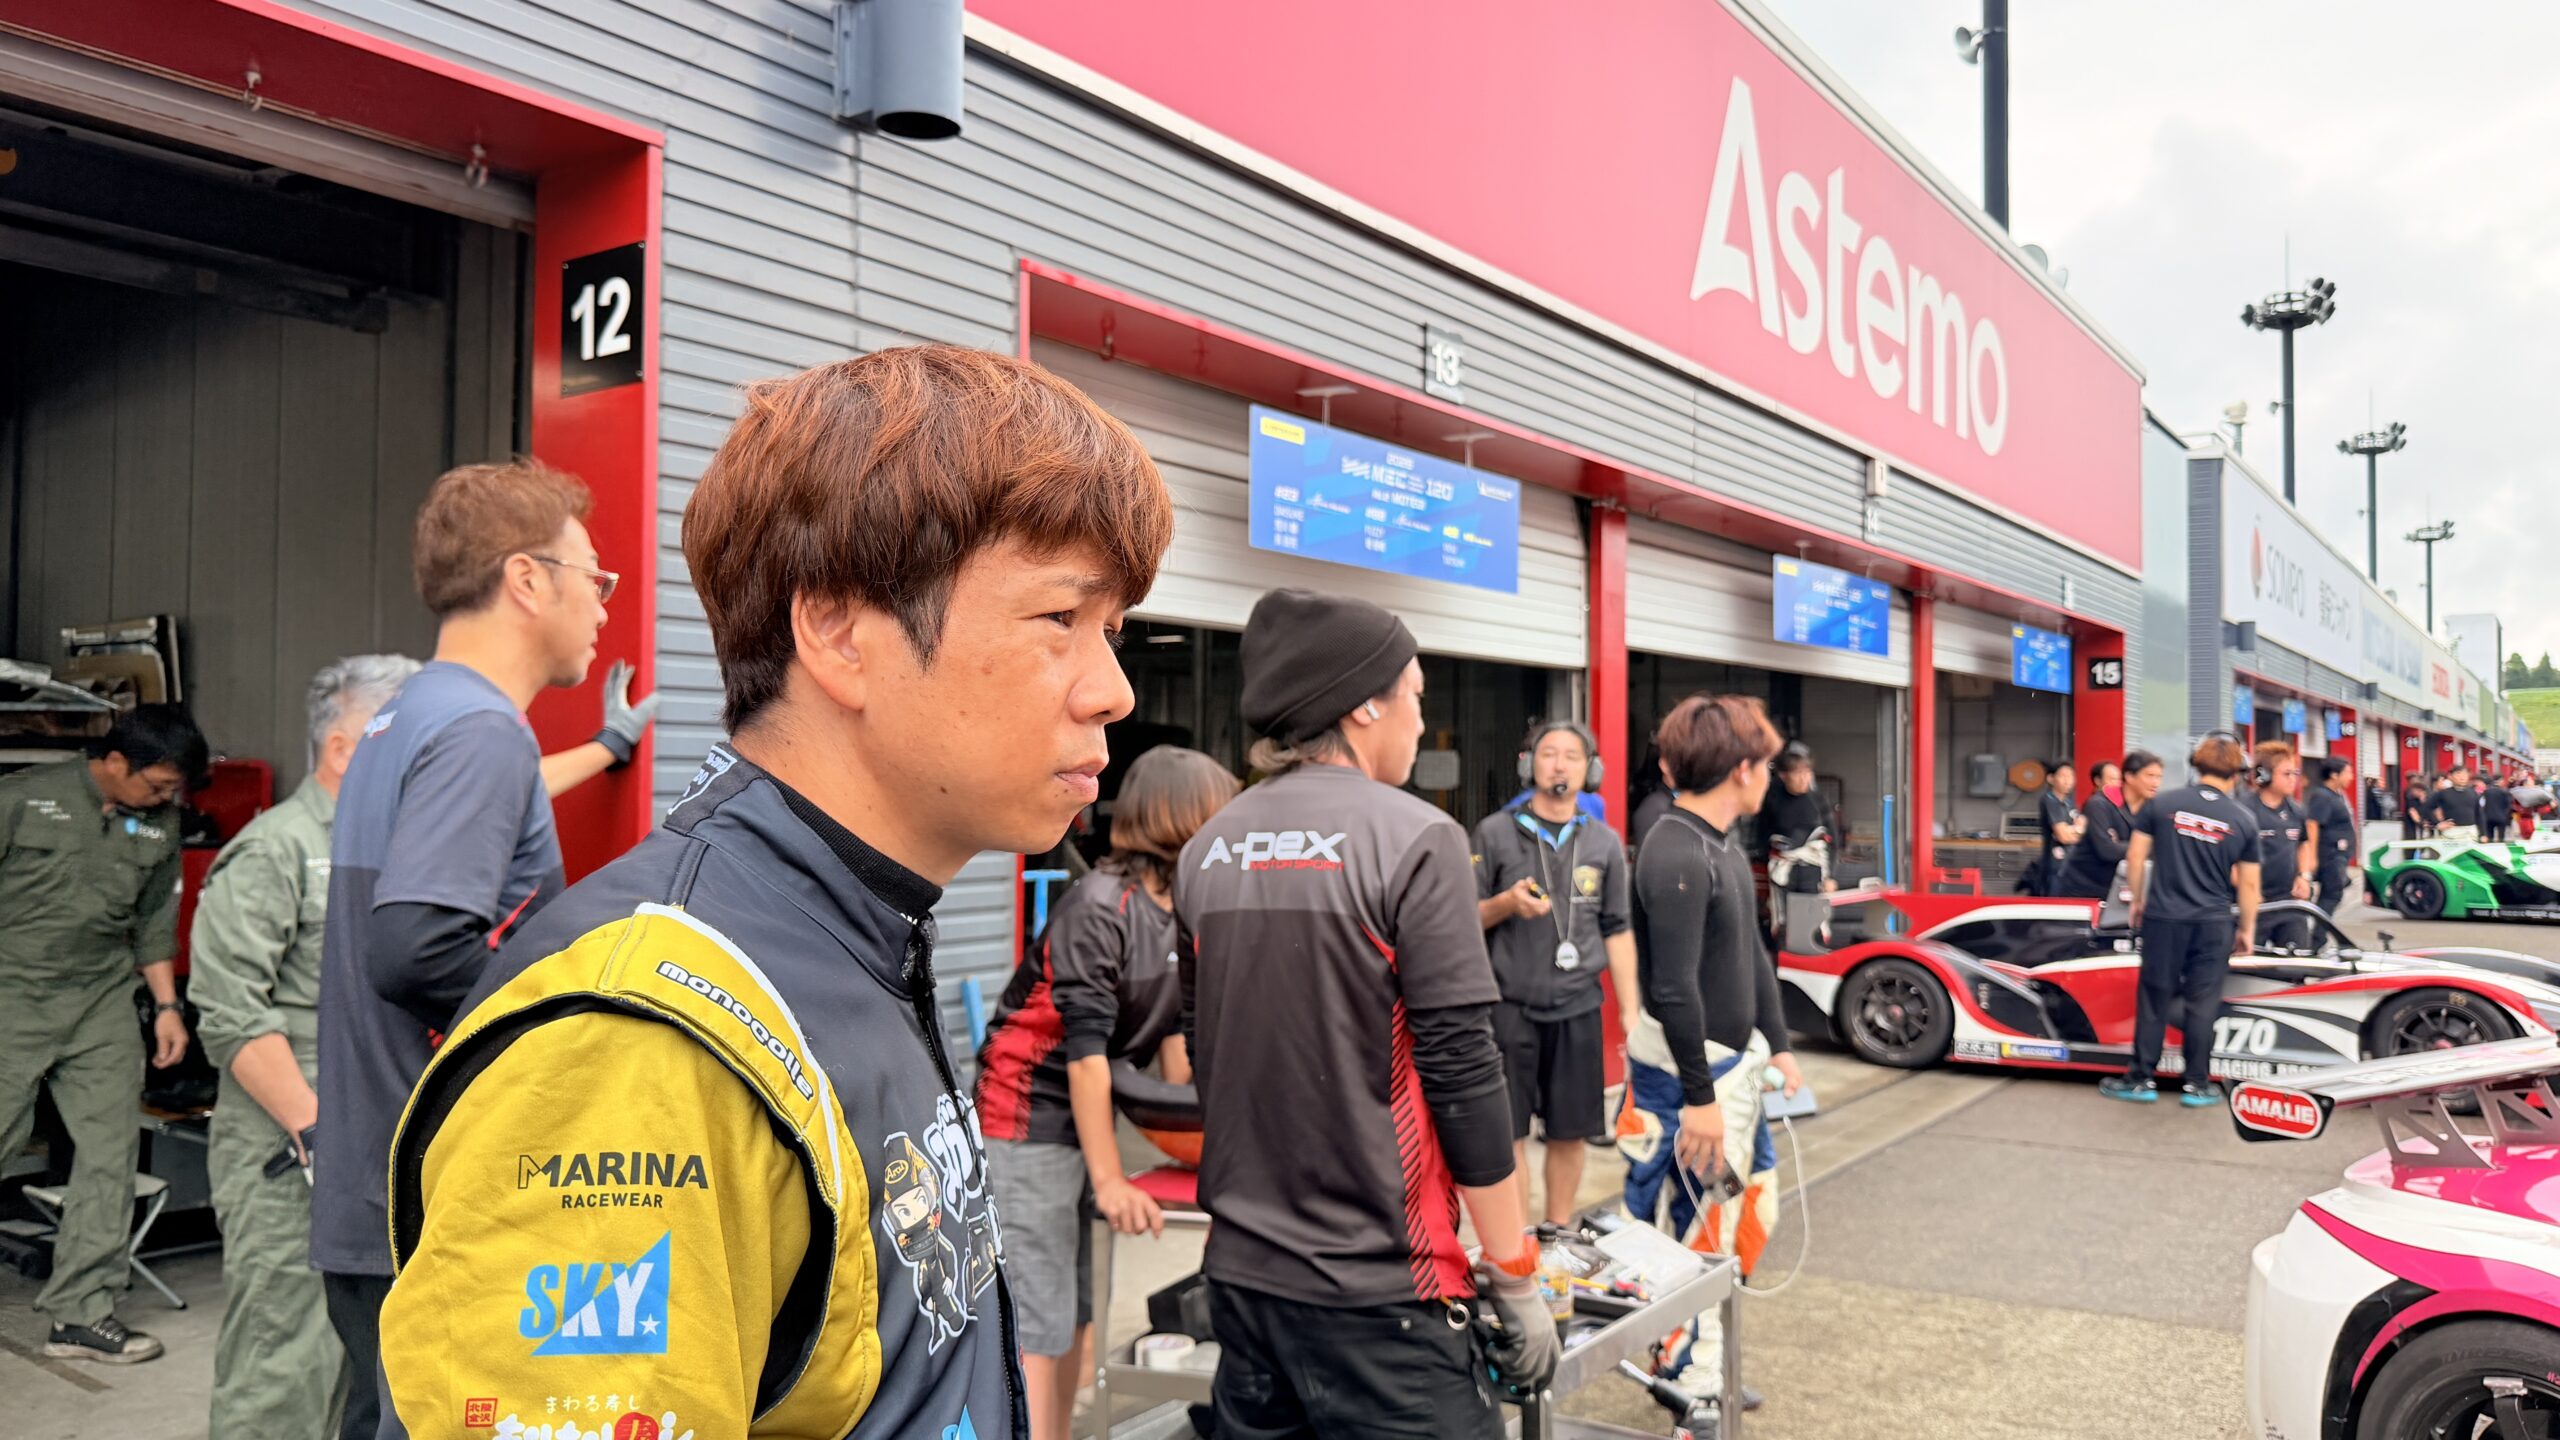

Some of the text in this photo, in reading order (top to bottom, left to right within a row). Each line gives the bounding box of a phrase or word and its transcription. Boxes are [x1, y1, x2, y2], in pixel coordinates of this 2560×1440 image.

[1690, 75, 2008, 457] Astemo
[571, 276, 631, 361] 12
[1432, 342, 1460, 386] 13
[2091, 661, 2121, 685] 15
[656, 961, 814, 1100] monocolle
[2213, 1017, 2277, 1056] 170
[2235, 1094, 2315, 1126] AMALIE
[518, 1152, 709, 1189] MARINA
[561, 1192, 663, 1209] RACEWEAR
[518, 1262, 655, 1339] SKY
[545, 1394, 642, 1413] まわる寿し
